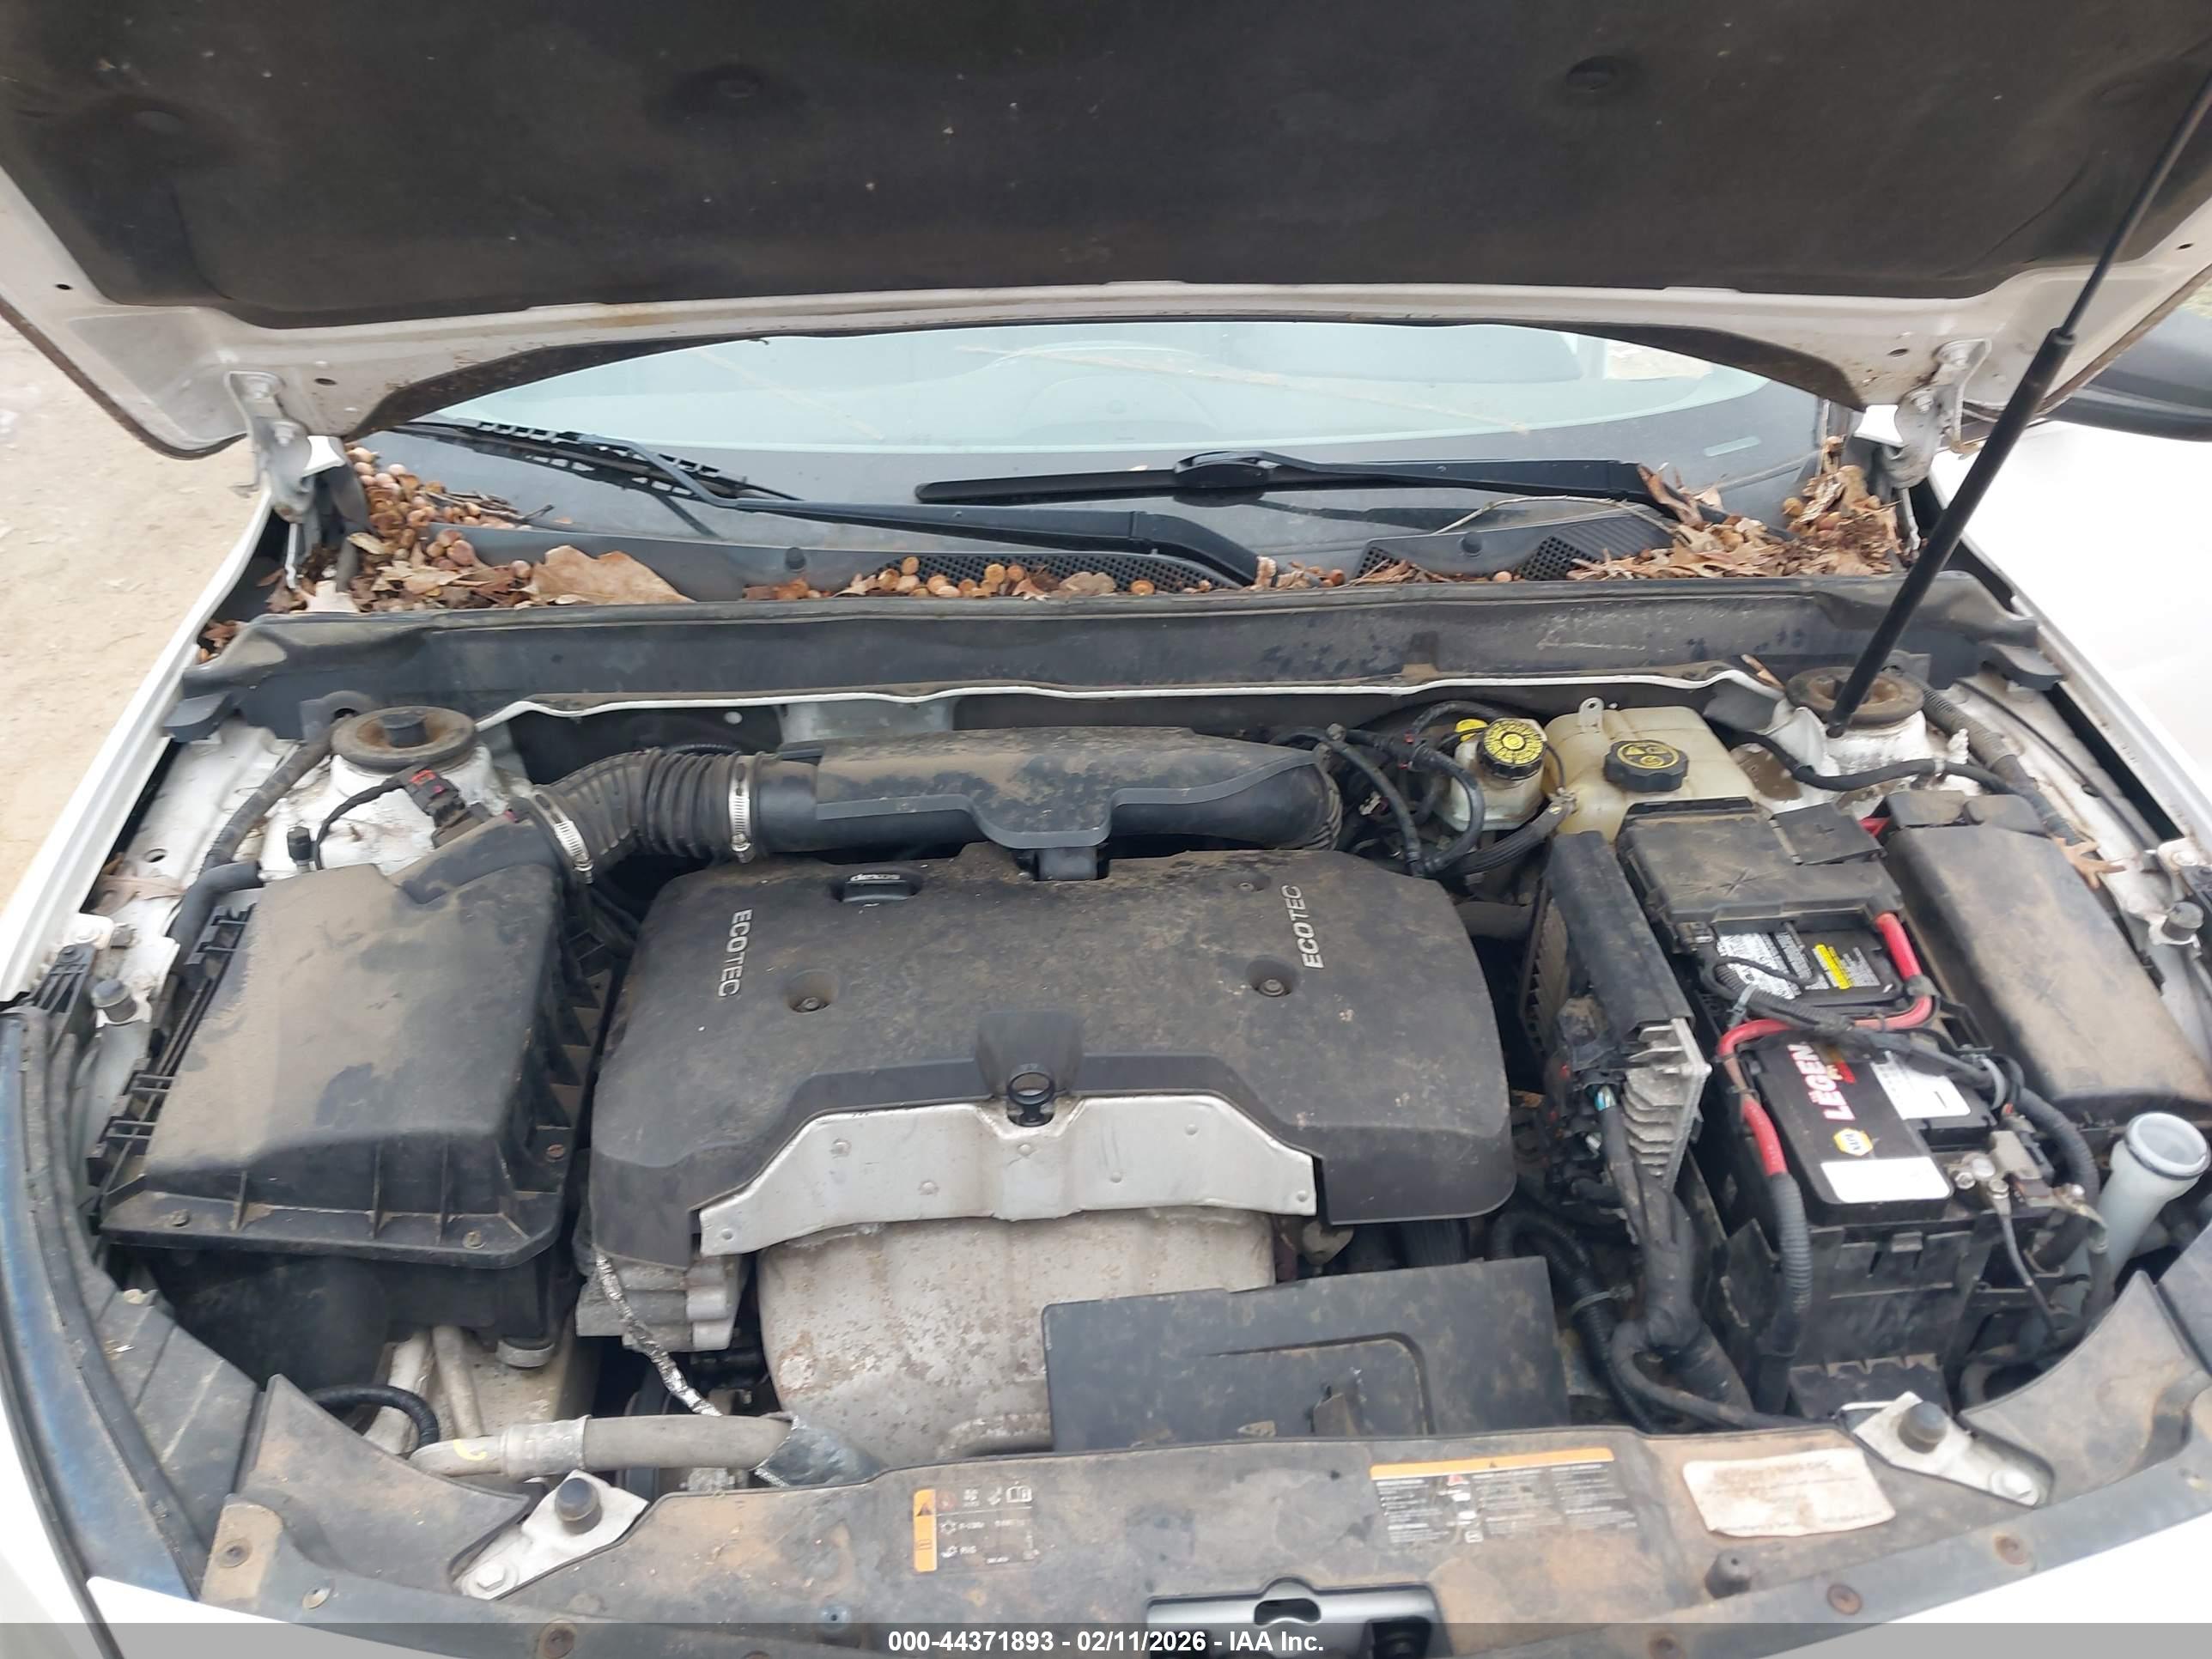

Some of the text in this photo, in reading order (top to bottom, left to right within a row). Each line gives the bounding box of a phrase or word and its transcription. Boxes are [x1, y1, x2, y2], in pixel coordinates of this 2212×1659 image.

[718, 908, 753, 997] ECOTEC
[1281, 884, 1324, 969] ECOTEC
[1786, 1041, 1856, 1121] LEGEN
